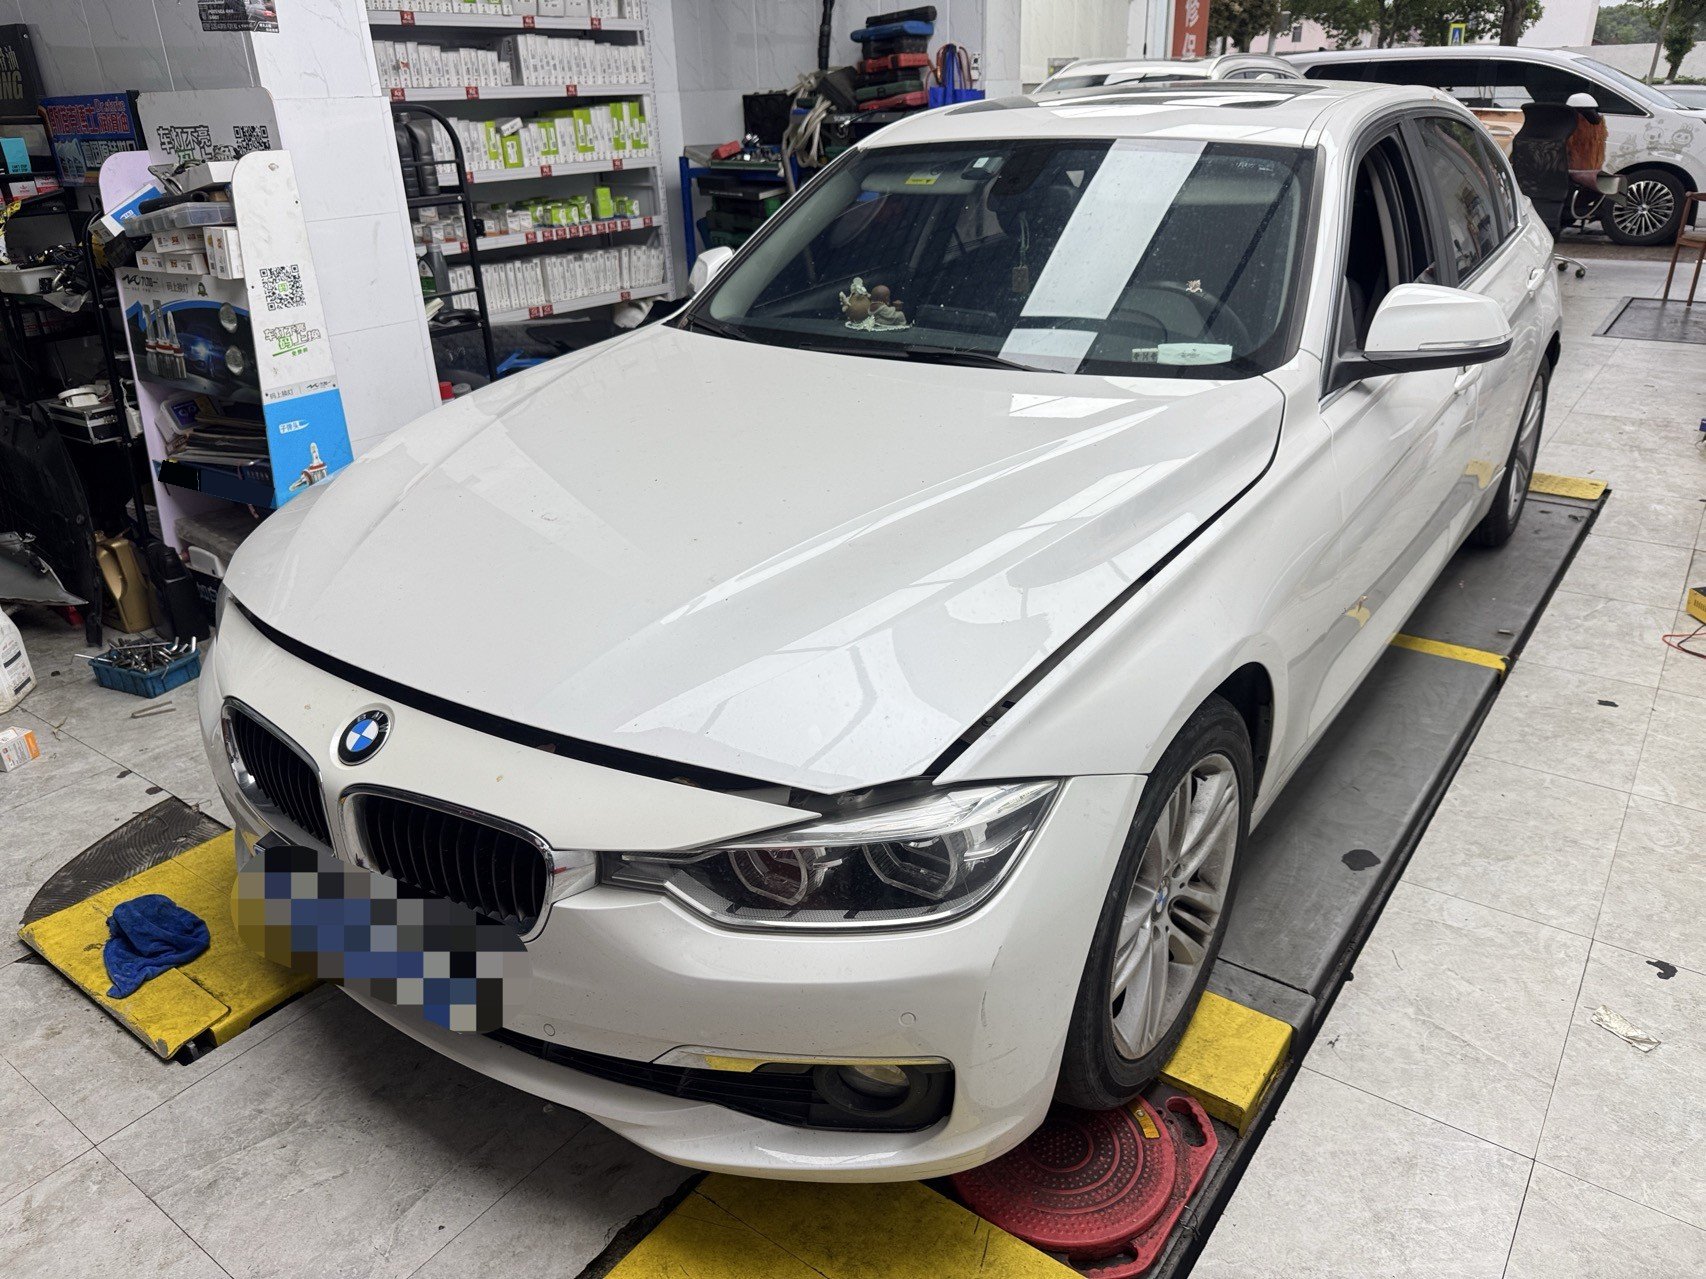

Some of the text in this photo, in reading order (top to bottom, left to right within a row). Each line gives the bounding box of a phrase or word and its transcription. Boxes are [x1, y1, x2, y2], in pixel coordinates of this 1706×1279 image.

[157, 125, 212, 155] 车灯不亮
[263, 323, 306, 342] 车灯不亮
[279, 328, 321, 350] 码上换
